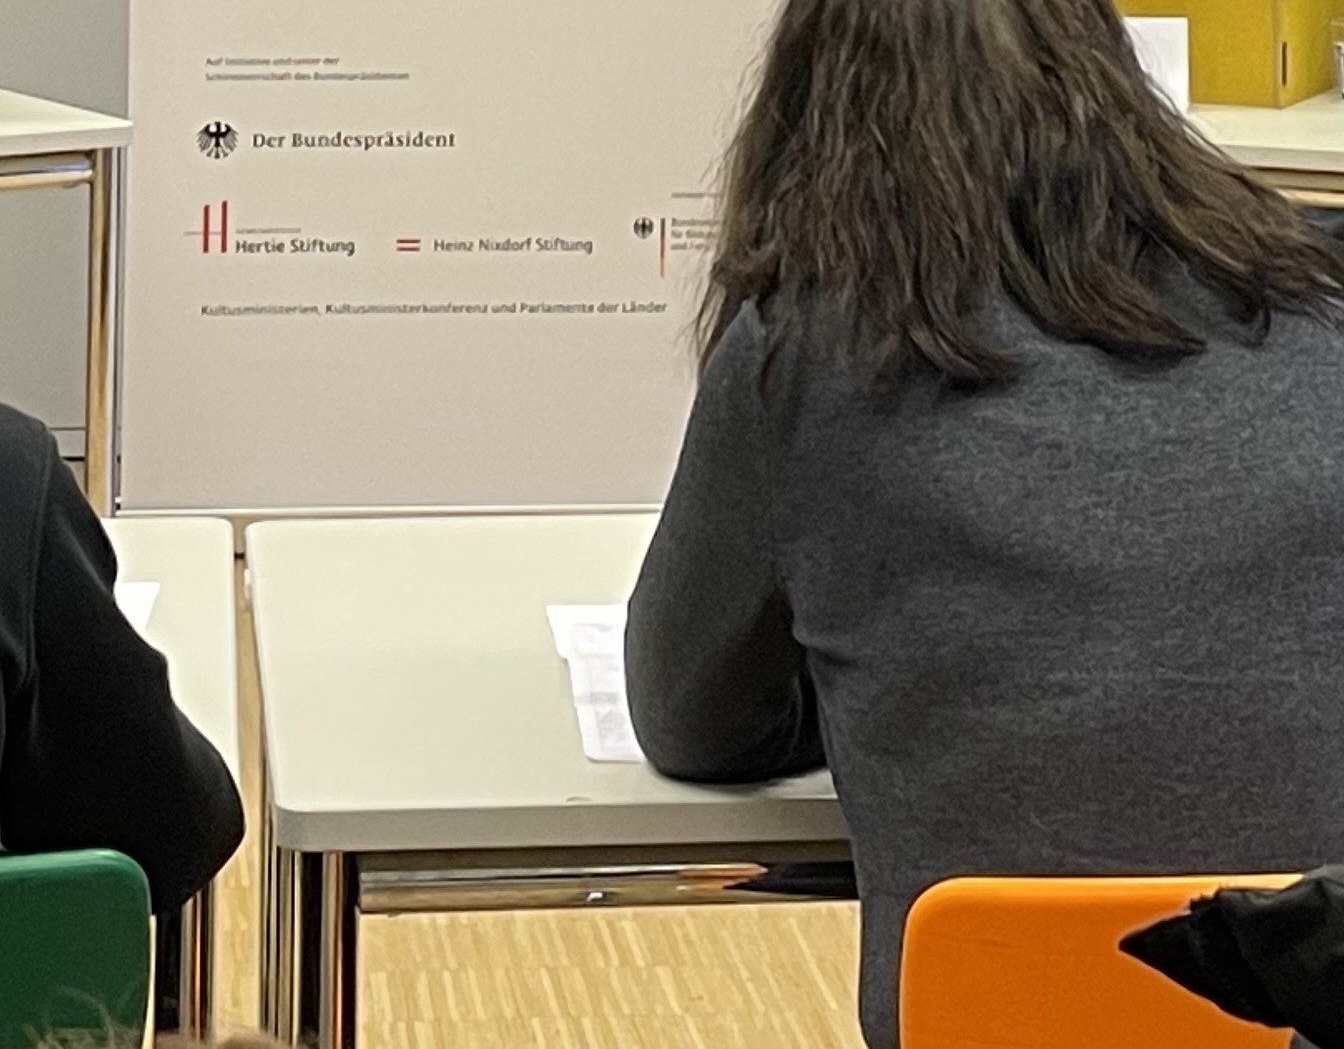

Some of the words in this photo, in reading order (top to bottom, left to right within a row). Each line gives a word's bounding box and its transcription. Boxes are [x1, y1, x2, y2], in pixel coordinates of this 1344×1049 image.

[252, 133, 286, 148] Der
[291, 131, 456, 151] Bundespräsident
[235, 238, 285, 254] Hertie
[290, 238, 356, 257] Stiftung
[433, 238, 474, 252] Heinz
[478, 237, 532, 252] Nixdorf
[535, 237, 594, 255] Stiftung
[491, 302, 517, 314] und
[622, 301, 668, 314] Länder
